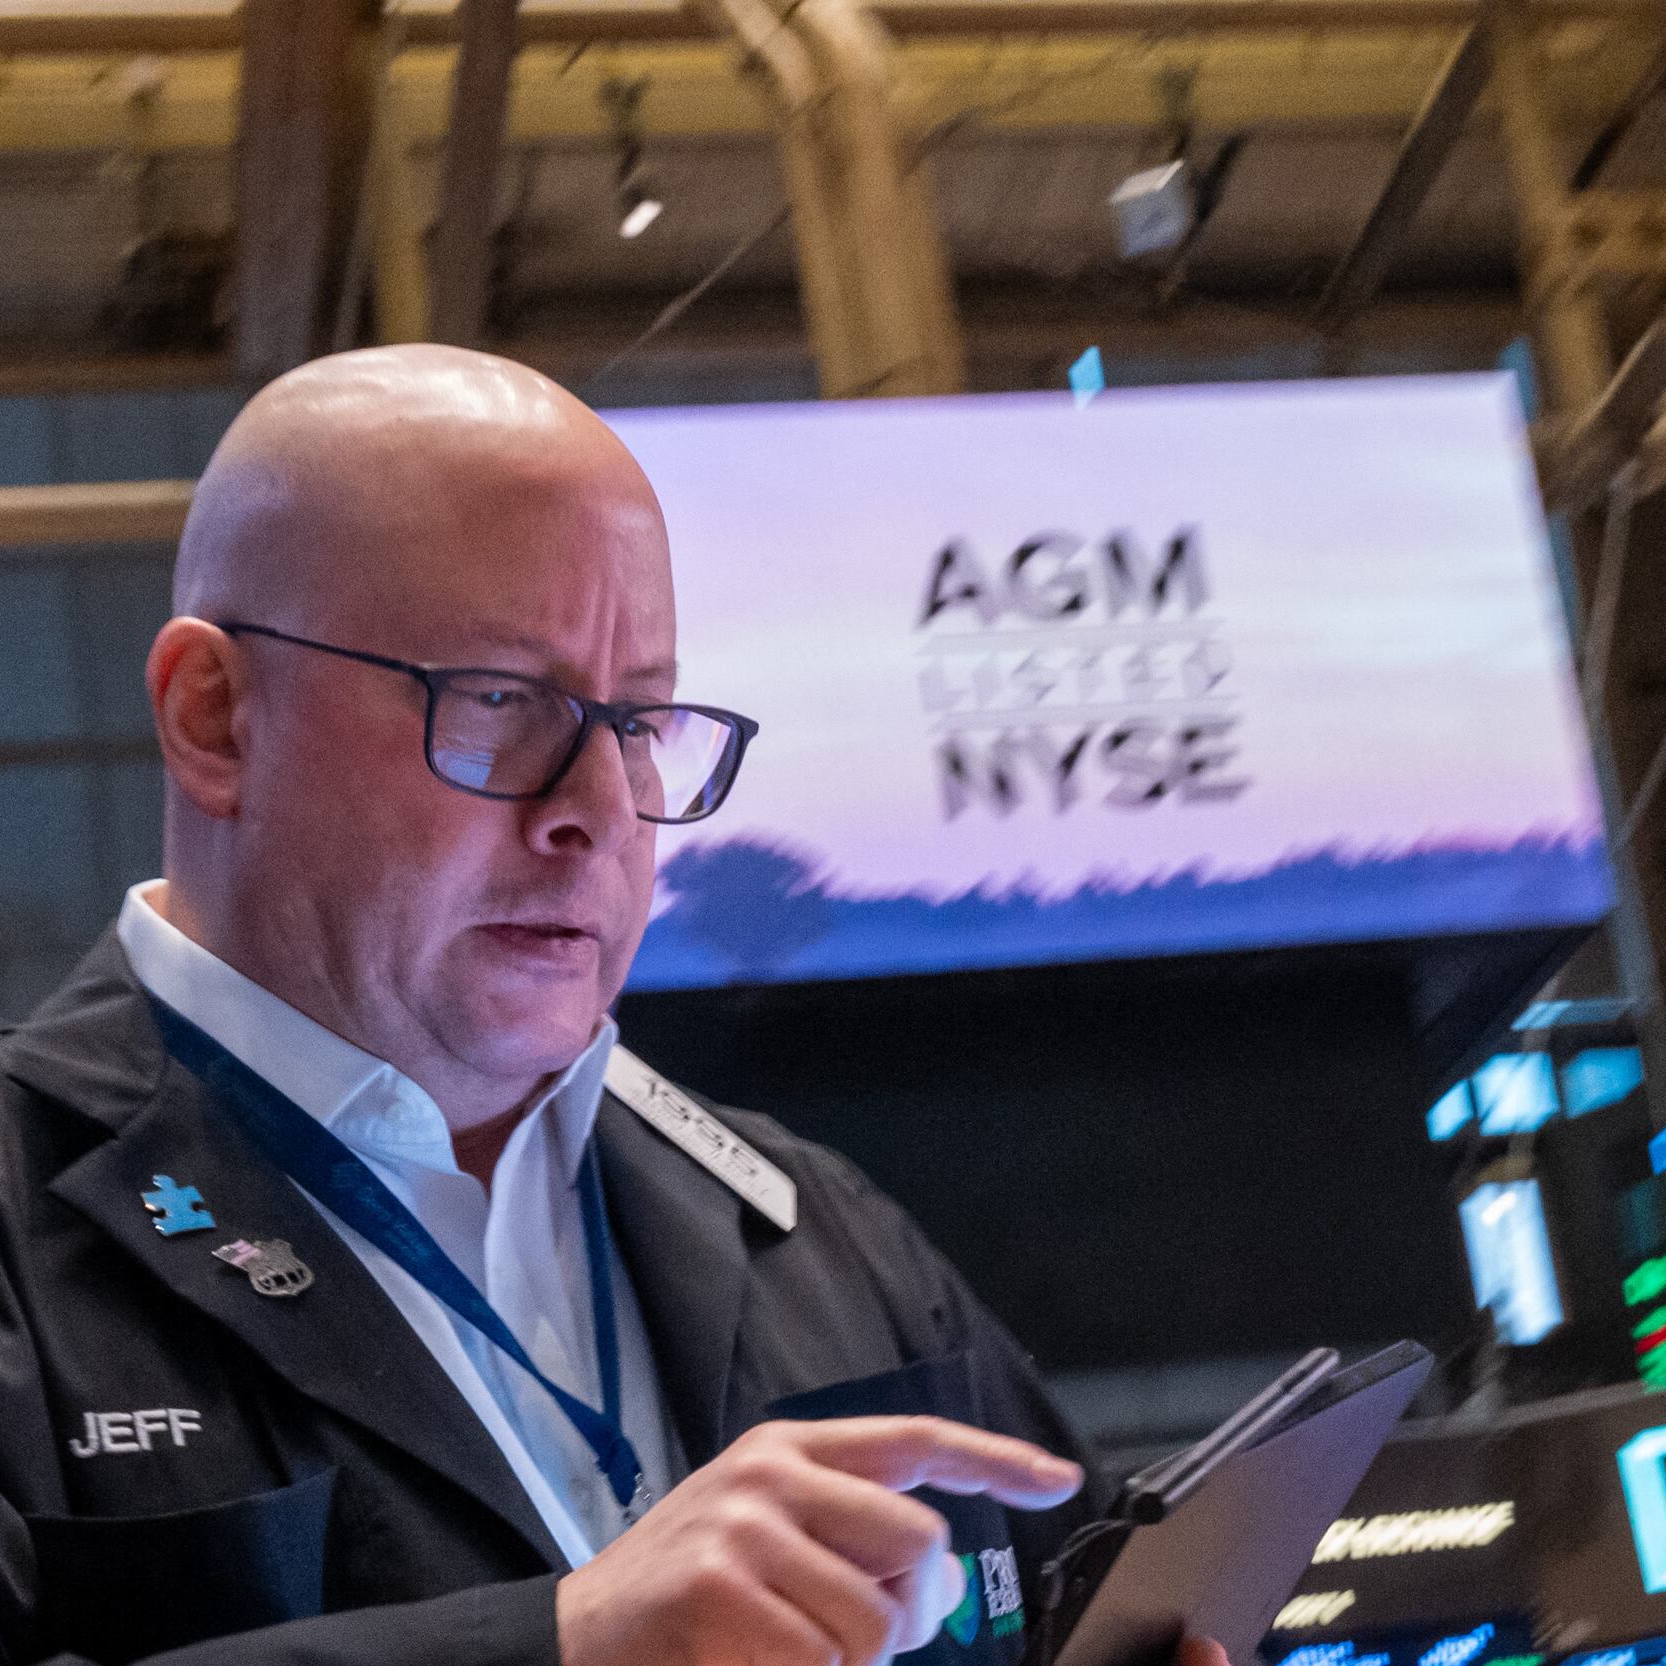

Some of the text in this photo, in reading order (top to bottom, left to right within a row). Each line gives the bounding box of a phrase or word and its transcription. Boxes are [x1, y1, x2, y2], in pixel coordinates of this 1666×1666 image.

[911, 524, 1213, 632] AGM
[937, 716, 1255, 825] NYSE
[68, 1407, 204, 1459] JEFF
